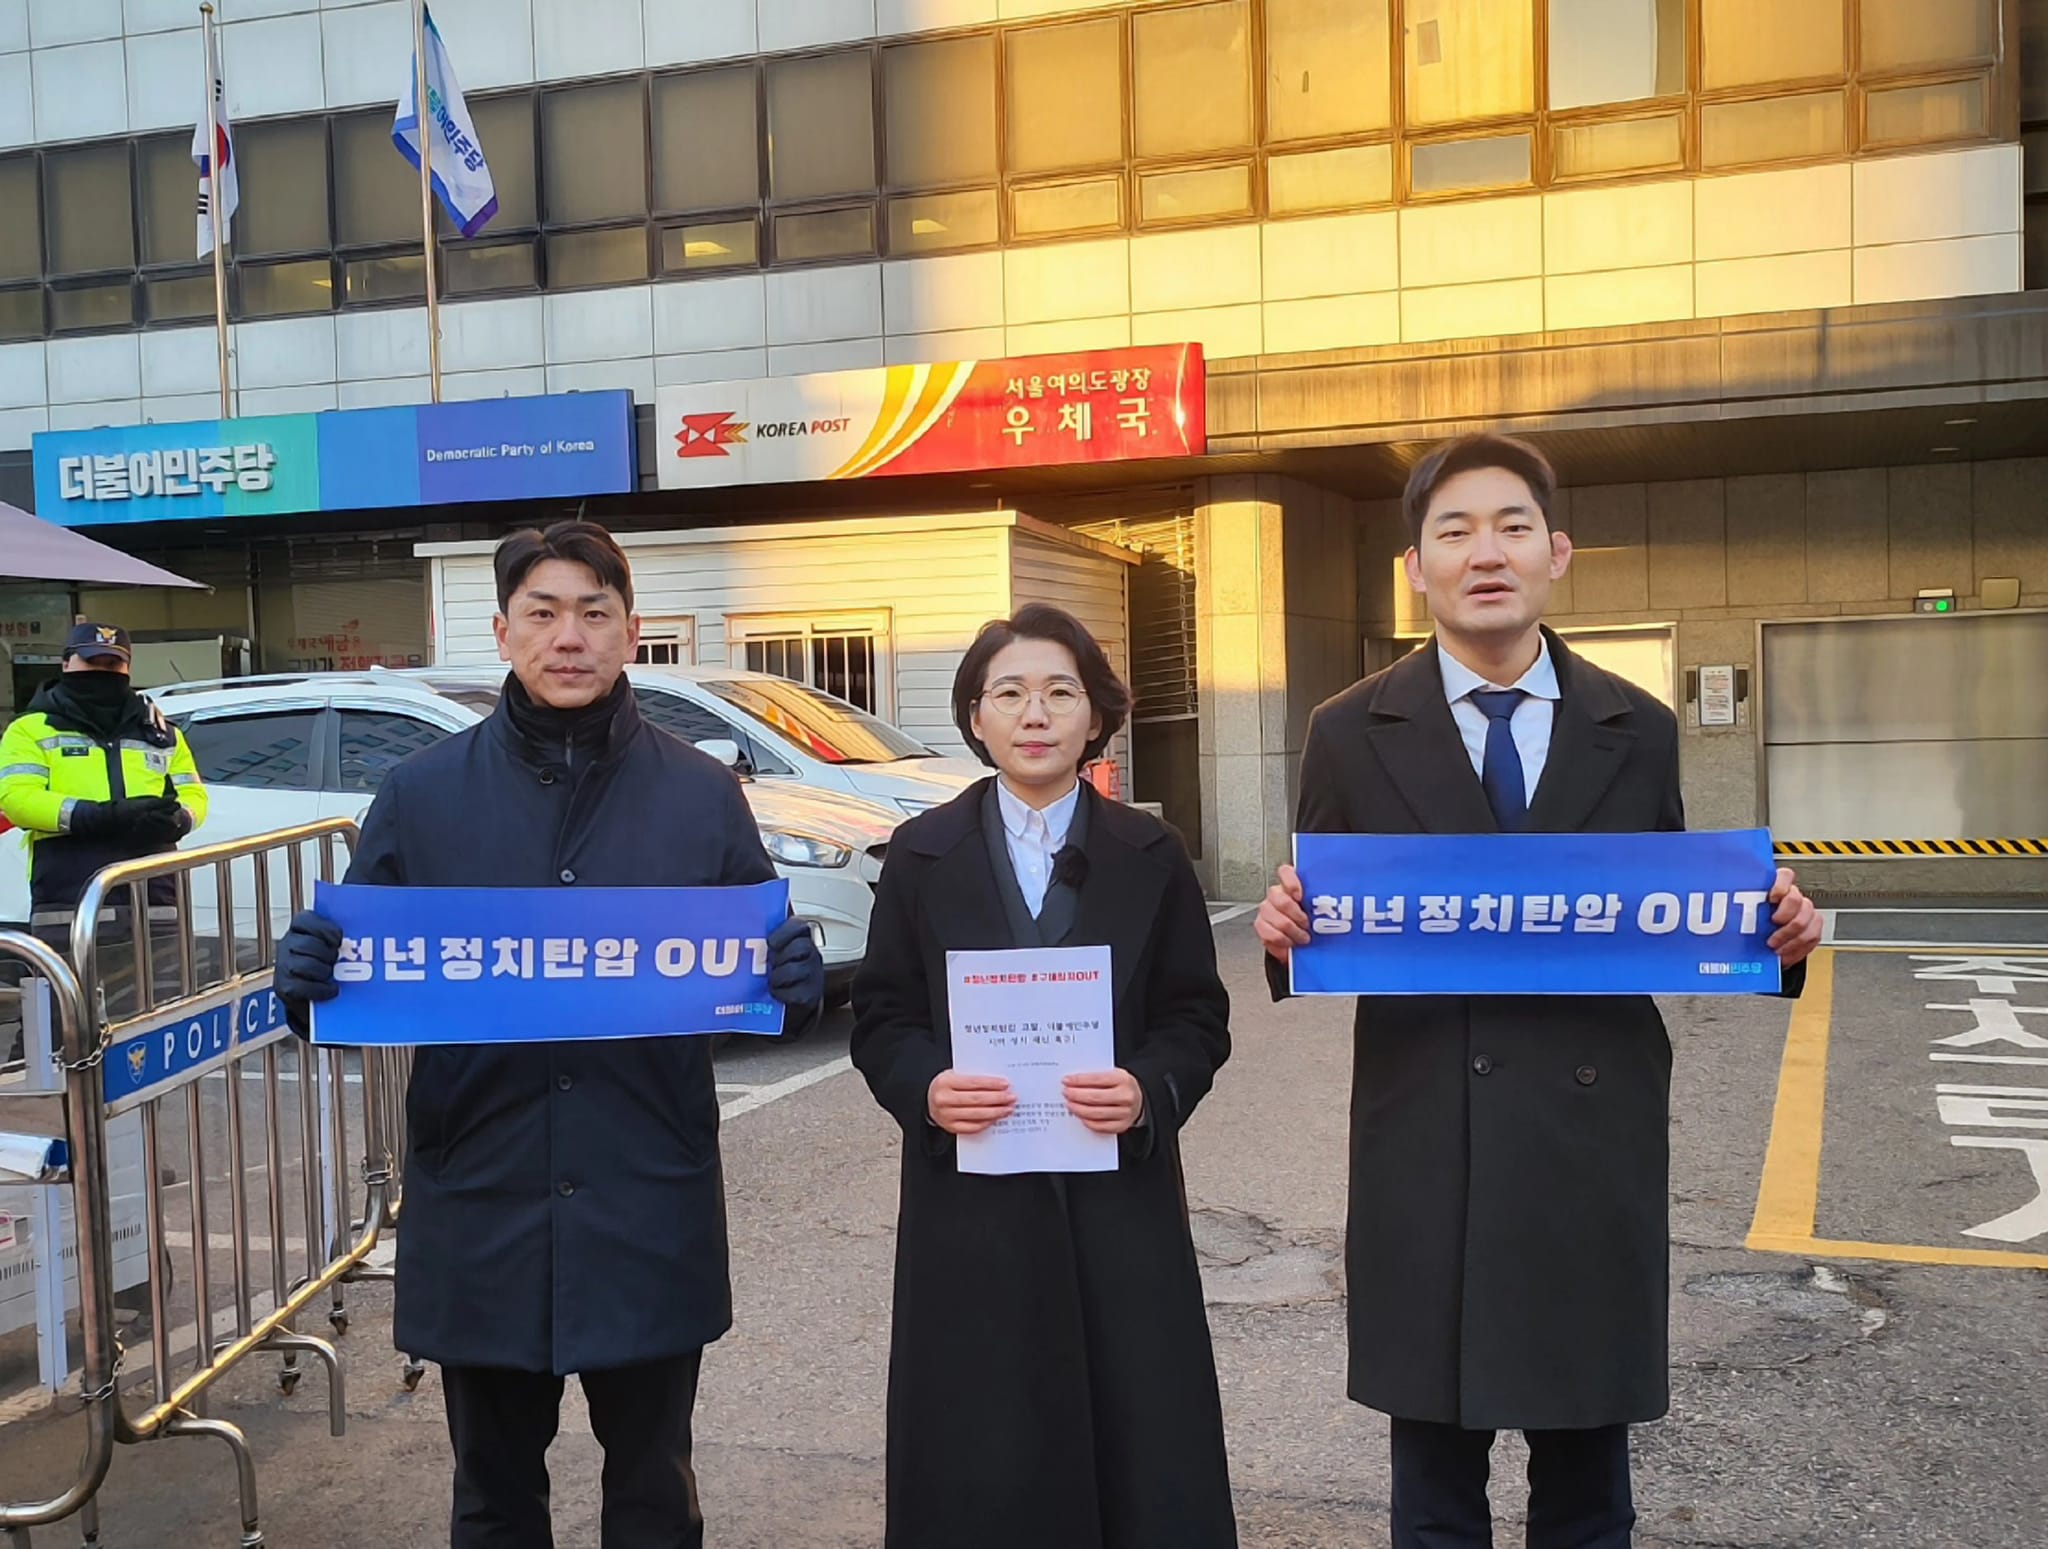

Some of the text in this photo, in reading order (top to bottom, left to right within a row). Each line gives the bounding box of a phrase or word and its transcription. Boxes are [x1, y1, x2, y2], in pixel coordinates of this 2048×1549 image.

[756, 417, 851, 438] KOREA POST
[1002, 397, 1151, 447] 우체국
[59, 443, 277, 501] 더불어민주당
[426, 440, 595, 462] Democratic Party of Korea
[1311, 891, 1768, 935] 청년 정치탄압 OUT
[333, 936, 769, 982] 청년 정치탄압 OUT
[163, 991, 277, 1071] POLCE
